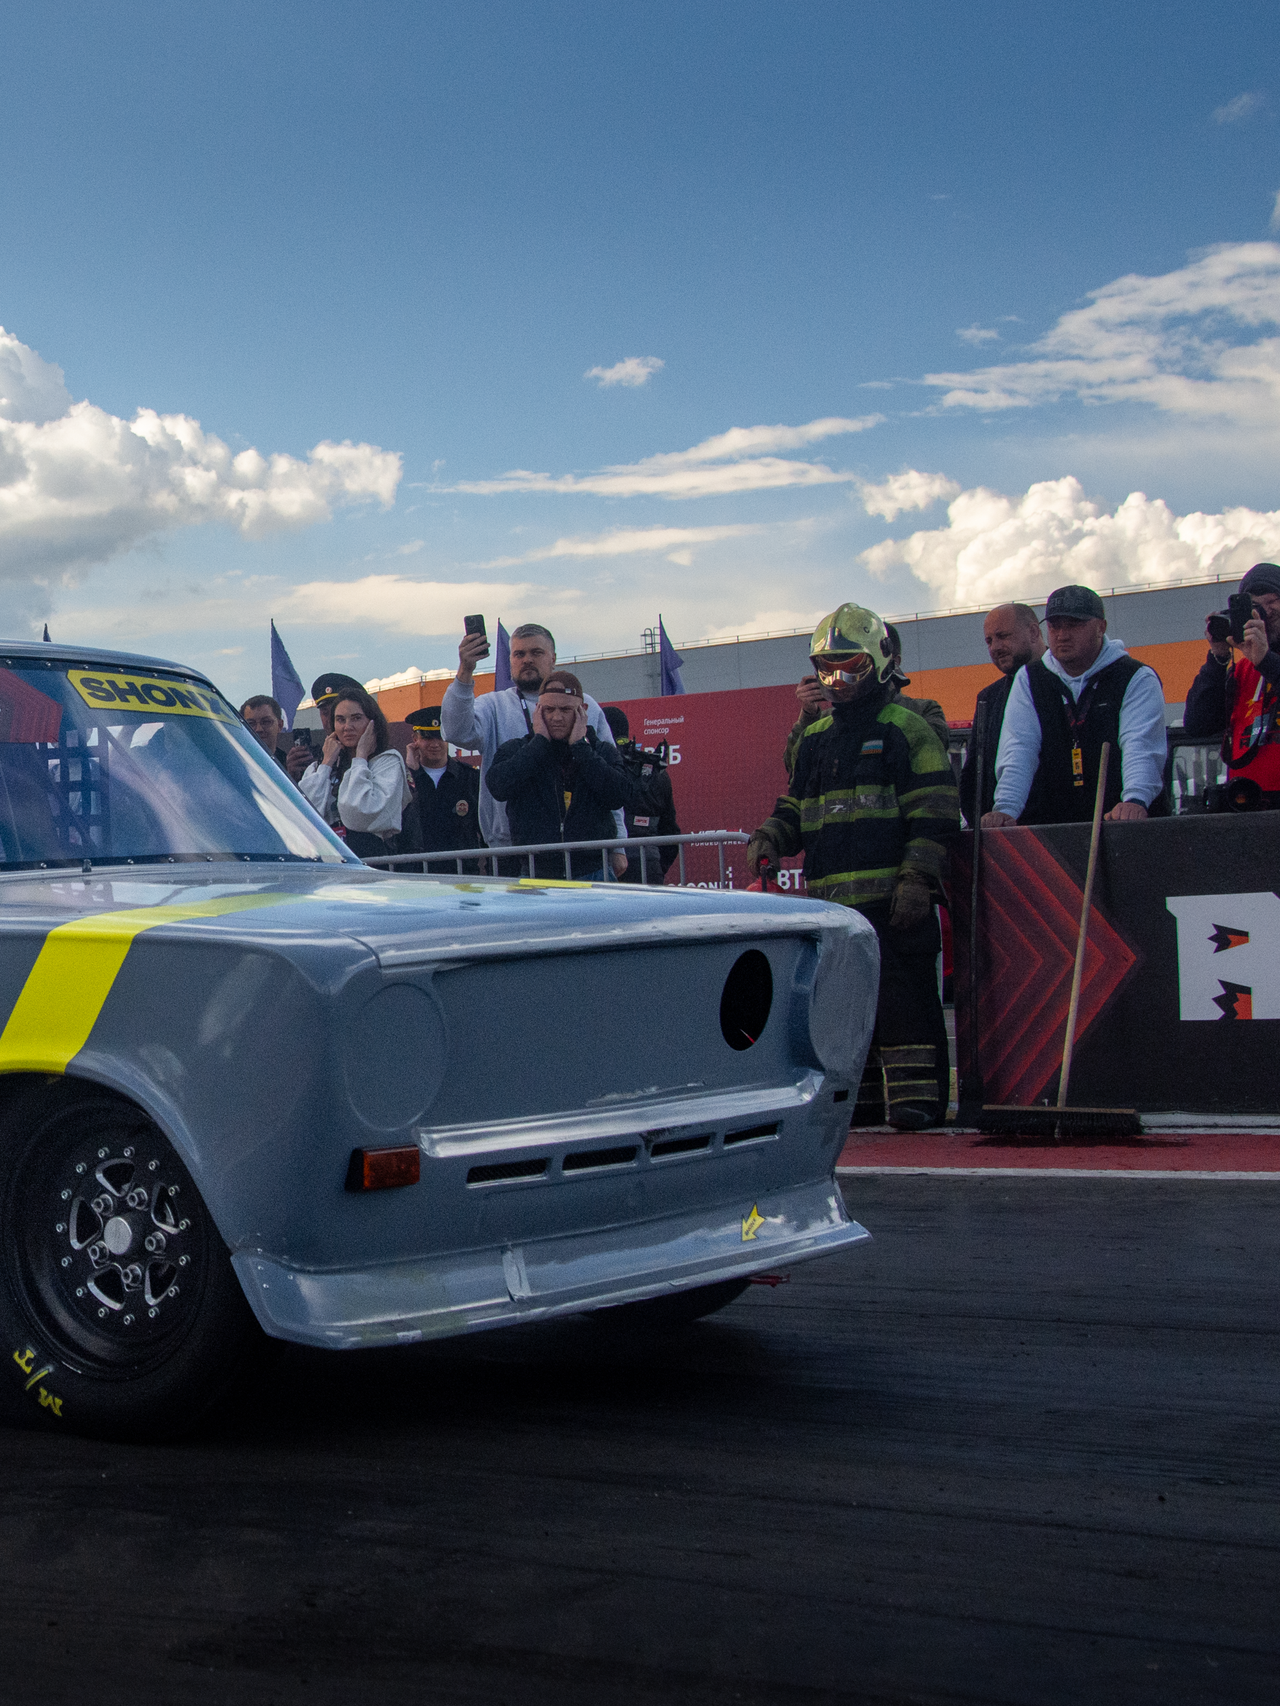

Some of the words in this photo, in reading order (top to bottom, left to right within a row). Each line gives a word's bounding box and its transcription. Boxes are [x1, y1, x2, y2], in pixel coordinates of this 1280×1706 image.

[80, 677, 234, 721] SHONX
[643, 716, 684, 726] Генеральный
[643, 727, 669, 735] спонсор
[777, 868, 807, 890] ВТ
